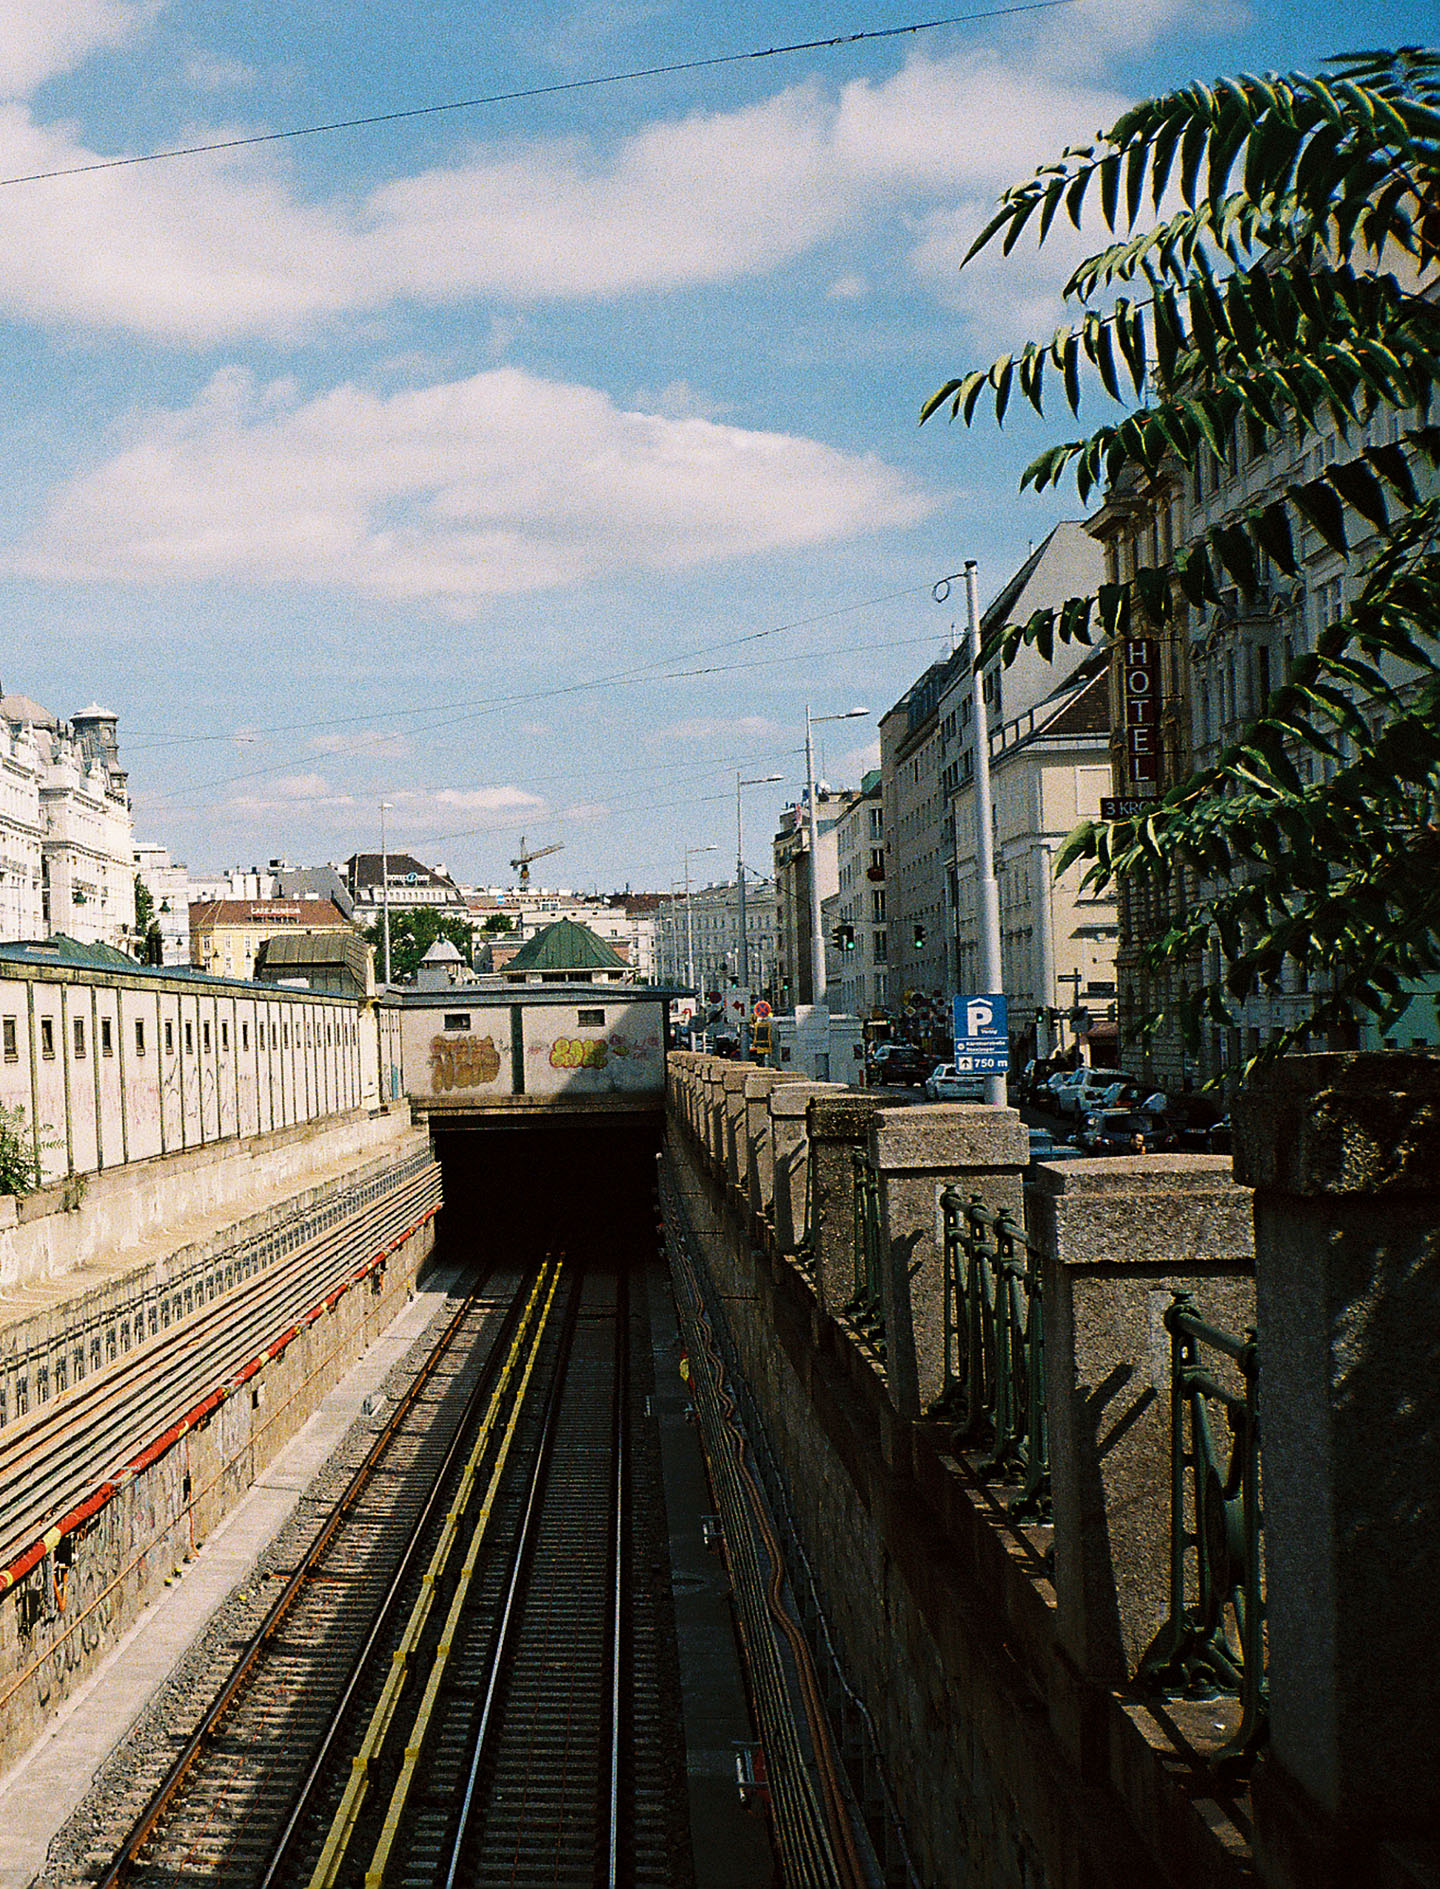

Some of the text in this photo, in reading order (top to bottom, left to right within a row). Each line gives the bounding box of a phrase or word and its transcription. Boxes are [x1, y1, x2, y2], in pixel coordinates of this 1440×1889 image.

[1128, 641, 1149, 782] HOTEL
[1105, 801, 1117, 816] 3
[967, 1006, 993, 1037] P
[974, 1058, 995, 1068] 750
